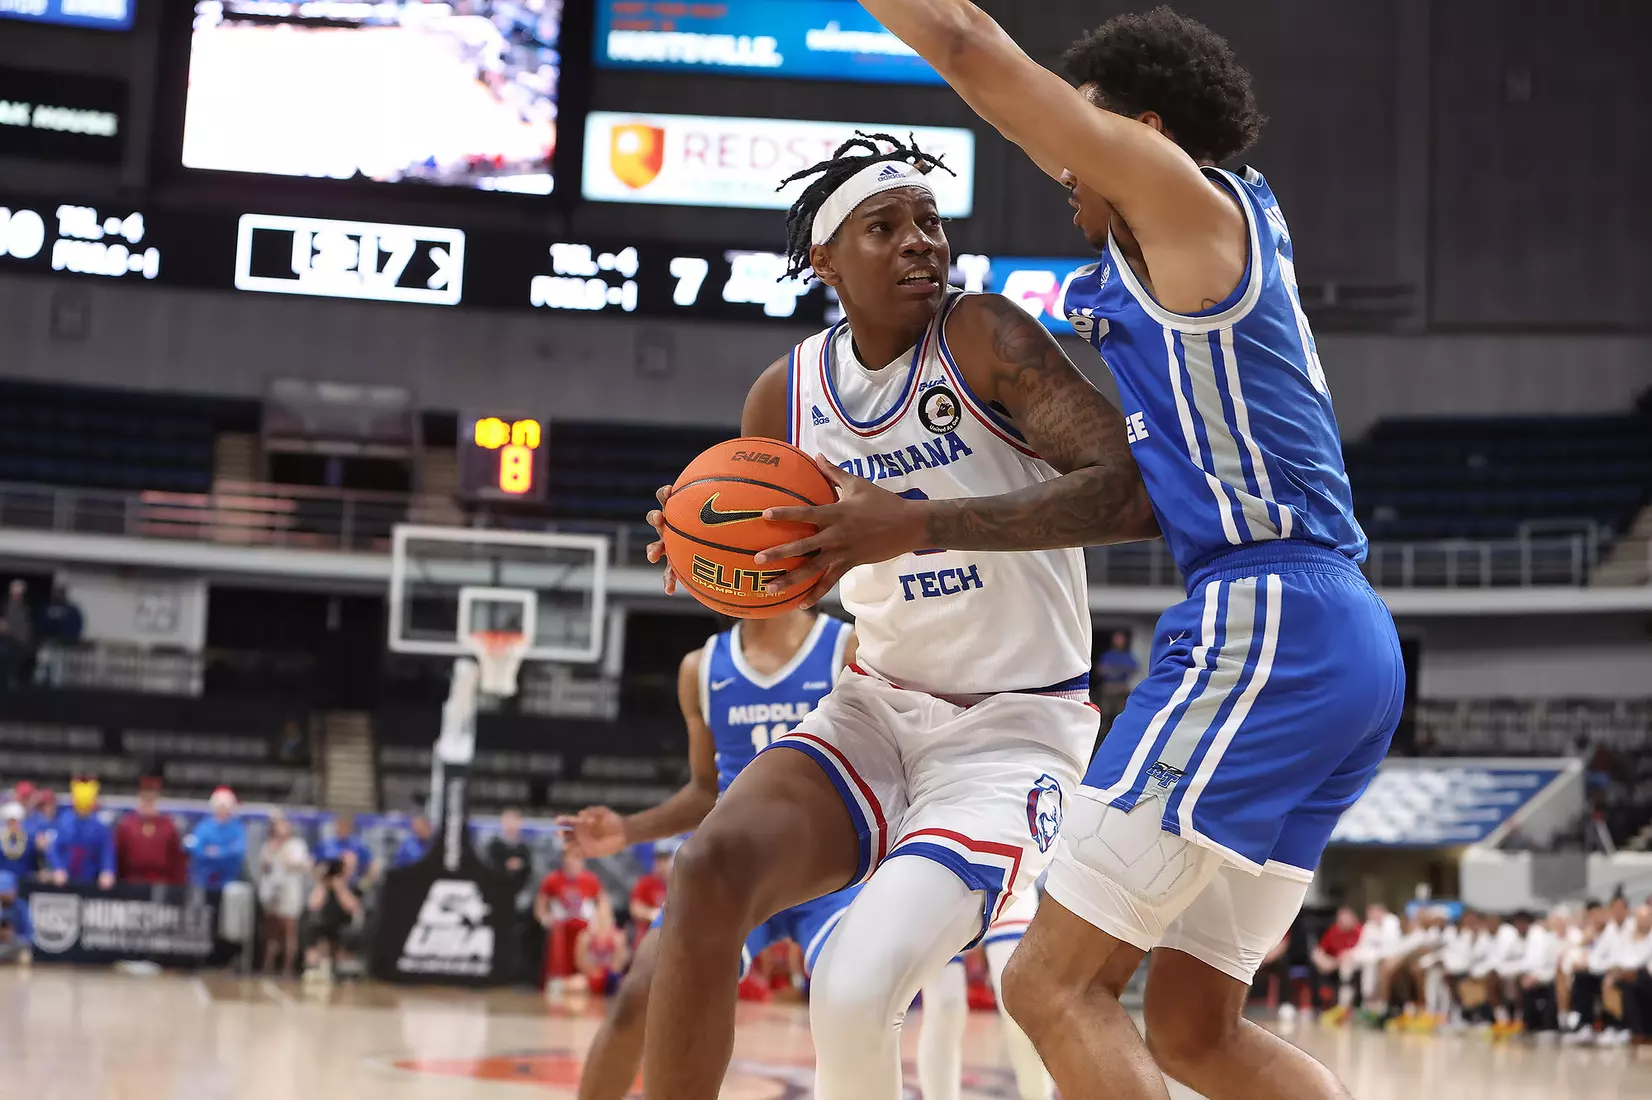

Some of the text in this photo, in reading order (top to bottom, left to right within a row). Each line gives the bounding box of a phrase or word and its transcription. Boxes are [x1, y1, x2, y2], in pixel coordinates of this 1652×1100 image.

[878, 173, 906, 182] adidas
[669, 256, 708, 306] 7
[929, 424, 947, 433] United
[500, 444, 533, 495] 8
[838, 431, 973, 483] OUISIANA
[898, 563, 984, 601] TECH
[727, 702, 811, 726] MIDDLE
